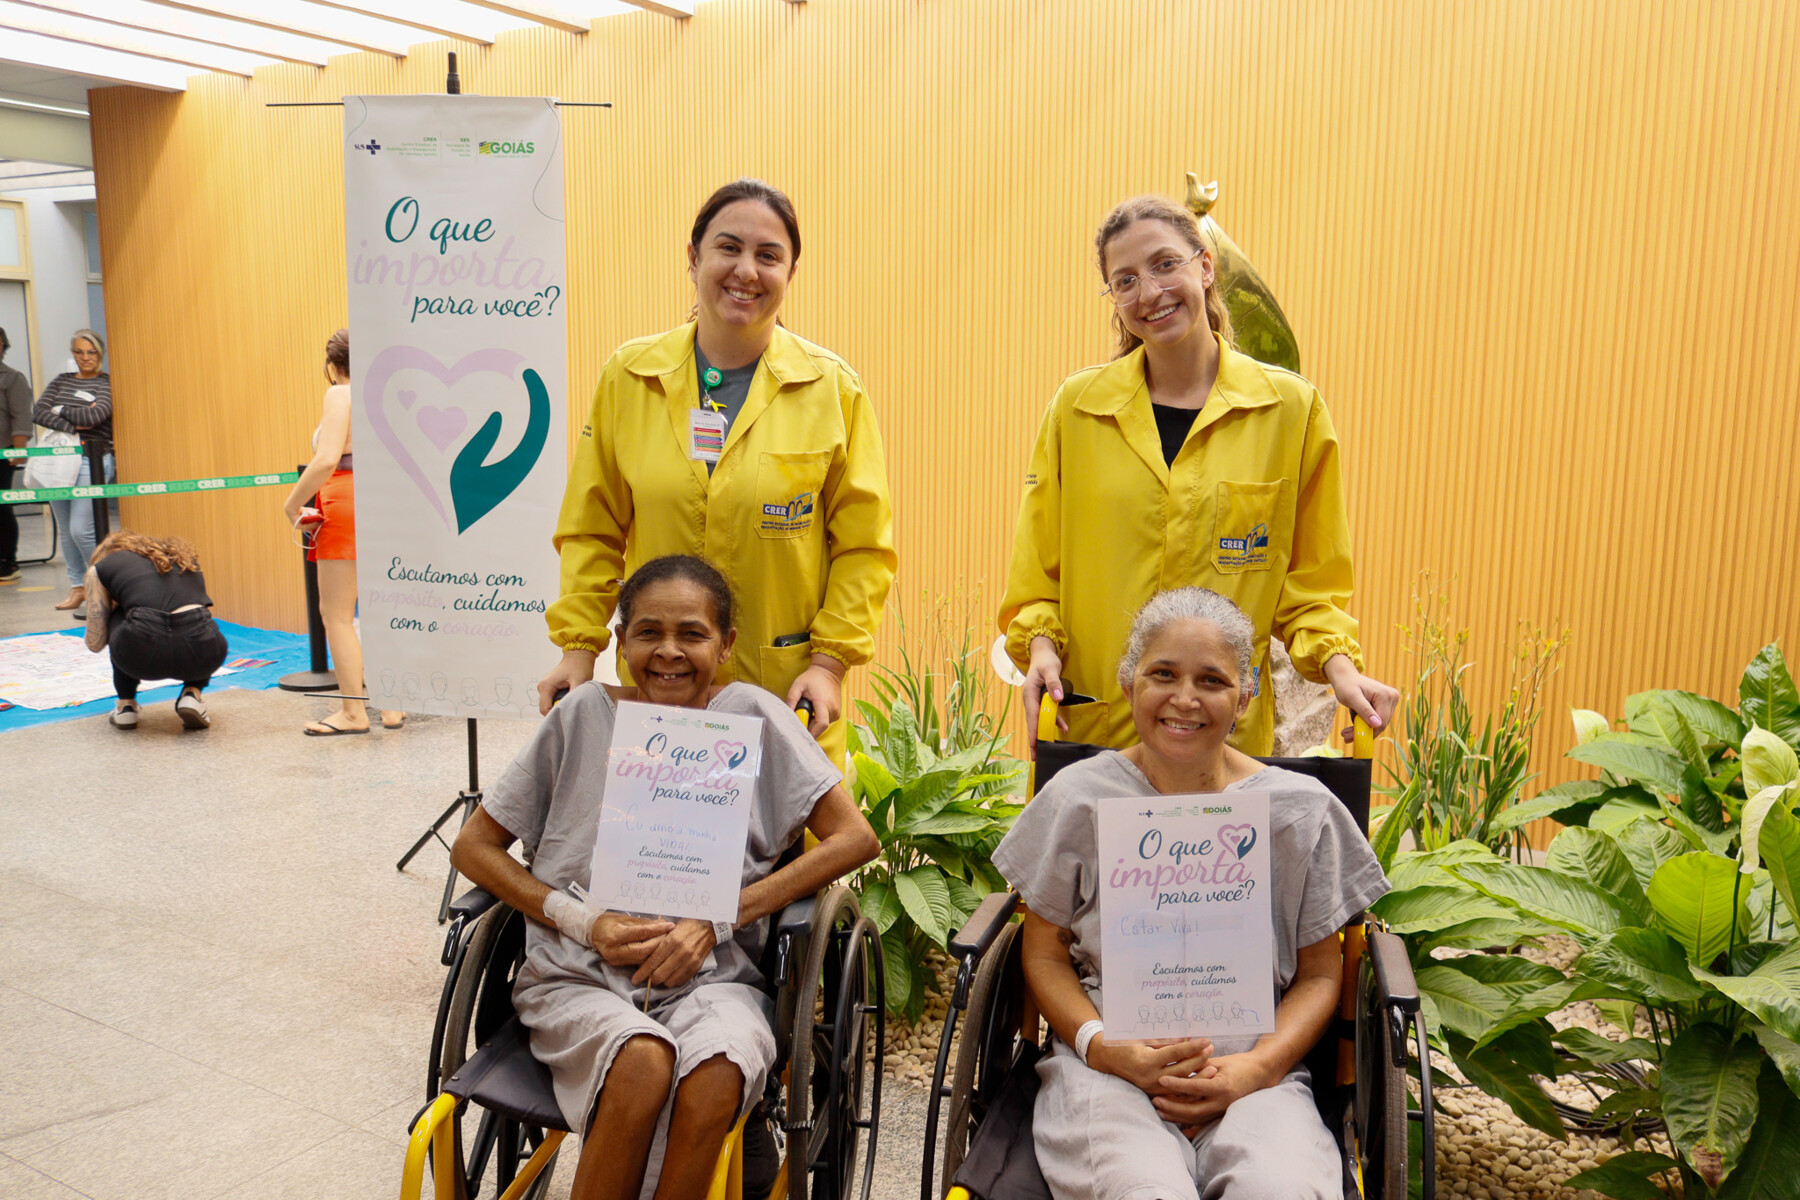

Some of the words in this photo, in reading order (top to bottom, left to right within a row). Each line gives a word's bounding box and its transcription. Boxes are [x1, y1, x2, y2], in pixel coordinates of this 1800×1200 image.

[489, 140, 535, 154] GOIÁS
[385, 196, 419, 243] O
[429, 218, 496, 255] que
[353, 235, 555, 306] importa
[411, 295, 478, 323] para
[484, 285, 560, 317] você?
[2, 491, 36, 501] CRER
[72, 487, 104, 497] CRER
[137, 484, 167, 494] CRER
[197, 479, 226, 489] CRER
[254, 475, 280, 485] CRER
[764, 505, 787, 516] CRER
[1221, 540, 1244, 550] CRER
[387, 556, 481, 586] Escutamos
[486, 573, 526, 587] com
[369, 588, 446, 610] propósito,
[453, 589, 546, 613] cuidamos
[390, 617, 424, 631] com
[428, 620, 439, 633] o
[442, 620, 519, 640] coração.
[645, 732, 667, 757] O
[671, 746, 709, 766] que
[616, 751, 738, 792] importa
[652, 786, 693, 802] para
[695, 788, 740, 806] você?
[1209, 806, 1232, 814] GOIÁS
[639, 845, 683, 861] Escutamos
[686, 854, 702, 863] com
[1138, 829, 1162, 859] O
[1169, 840, 1214, 865] que
[637, 871, 653, 880] com
[670, 862, 710, 876] cuidamos
[1109, 849, 1252, 900] importa
[1156, 890, 1202, 911] para
[1206, 879, 1256, 902] você?
[1152, 962, 1203, 975] Escutamos
[1206, 965, 1226, 973] com
[1141, 977, 1187, 991] propósito,
[1191, 973, 1236, 986] cuidamos
[1155, 992, 1174, 1000] com
[1185, 987, 1224, 999] coração.
